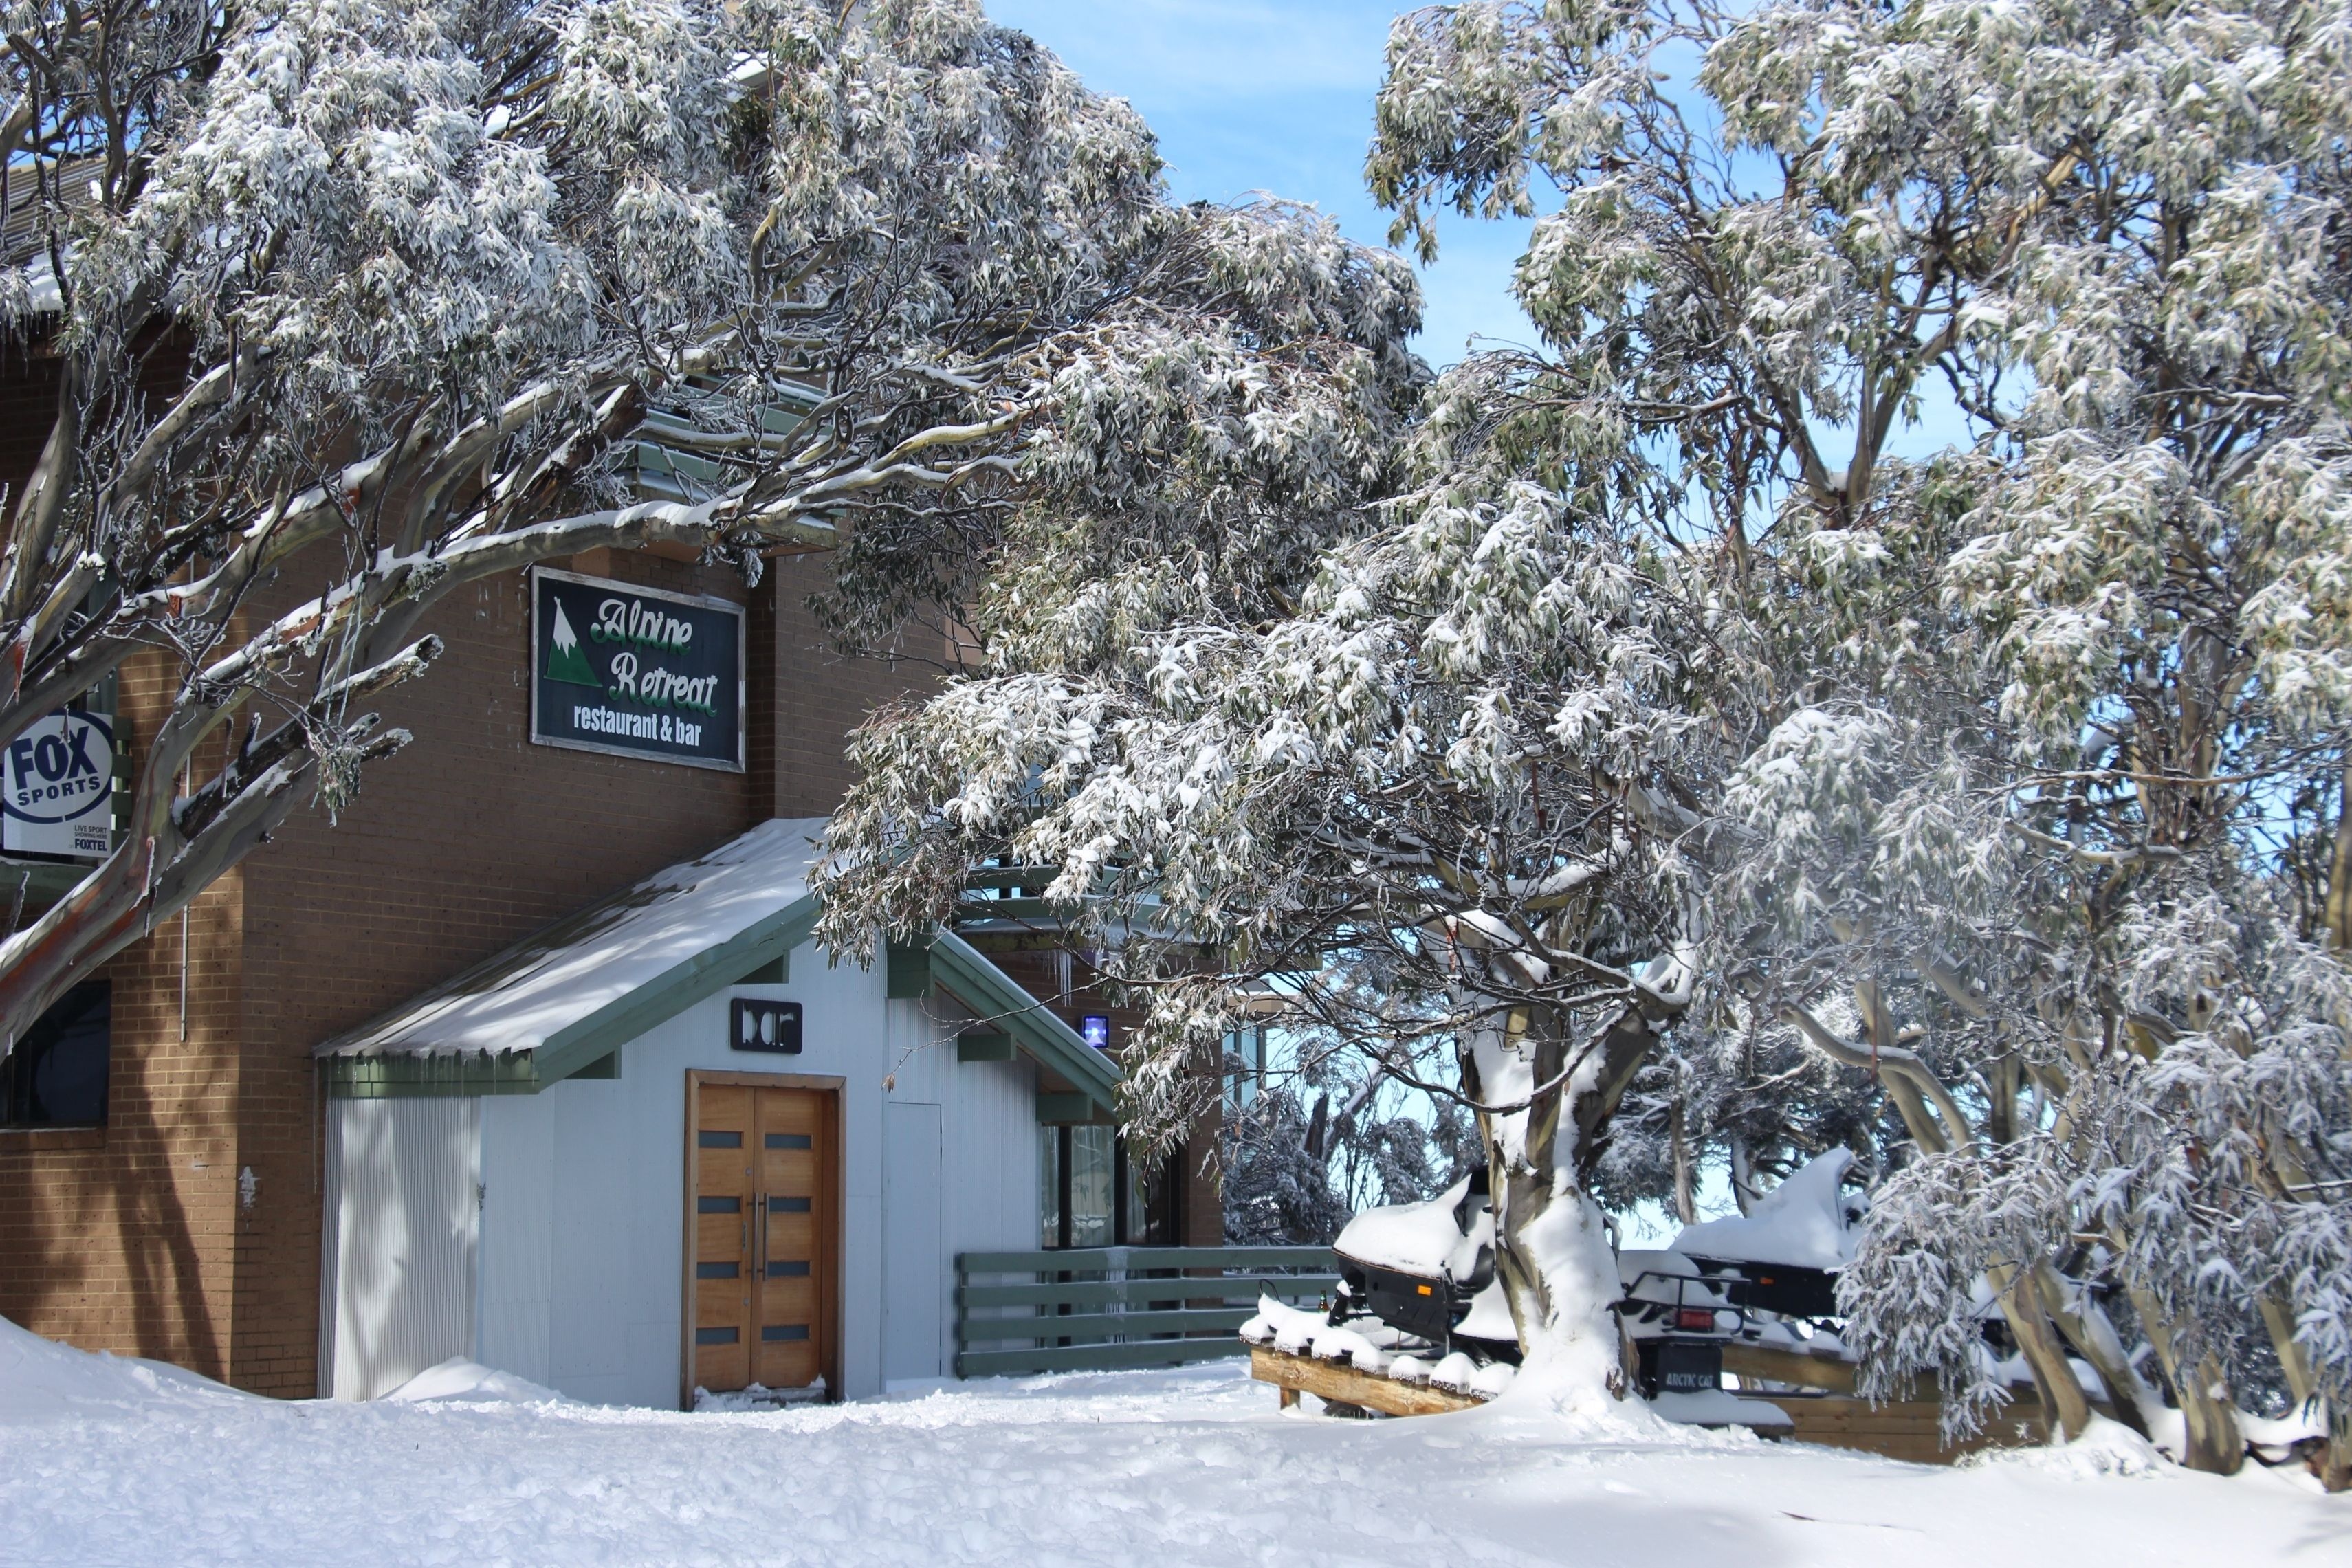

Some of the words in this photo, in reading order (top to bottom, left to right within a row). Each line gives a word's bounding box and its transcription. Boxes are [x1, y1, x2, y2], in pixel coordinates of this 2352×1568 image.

[591, 599, 692, 654] Alpine
[609, 652, 718, 717] Retreat
[574, 705, 657, 740] restaurant
[660, 715, 672, 742] &
[676, 717, 701, 746] bar
[10, 726, 98, 790] FOX
[17, 776, 100, 806] SPORTS
[75, 838, 107, 852] FOXTEL
[1666, 1373, 1696, 1387] ARCTIC
[1698, 1374, 1713, 1387] CAT
